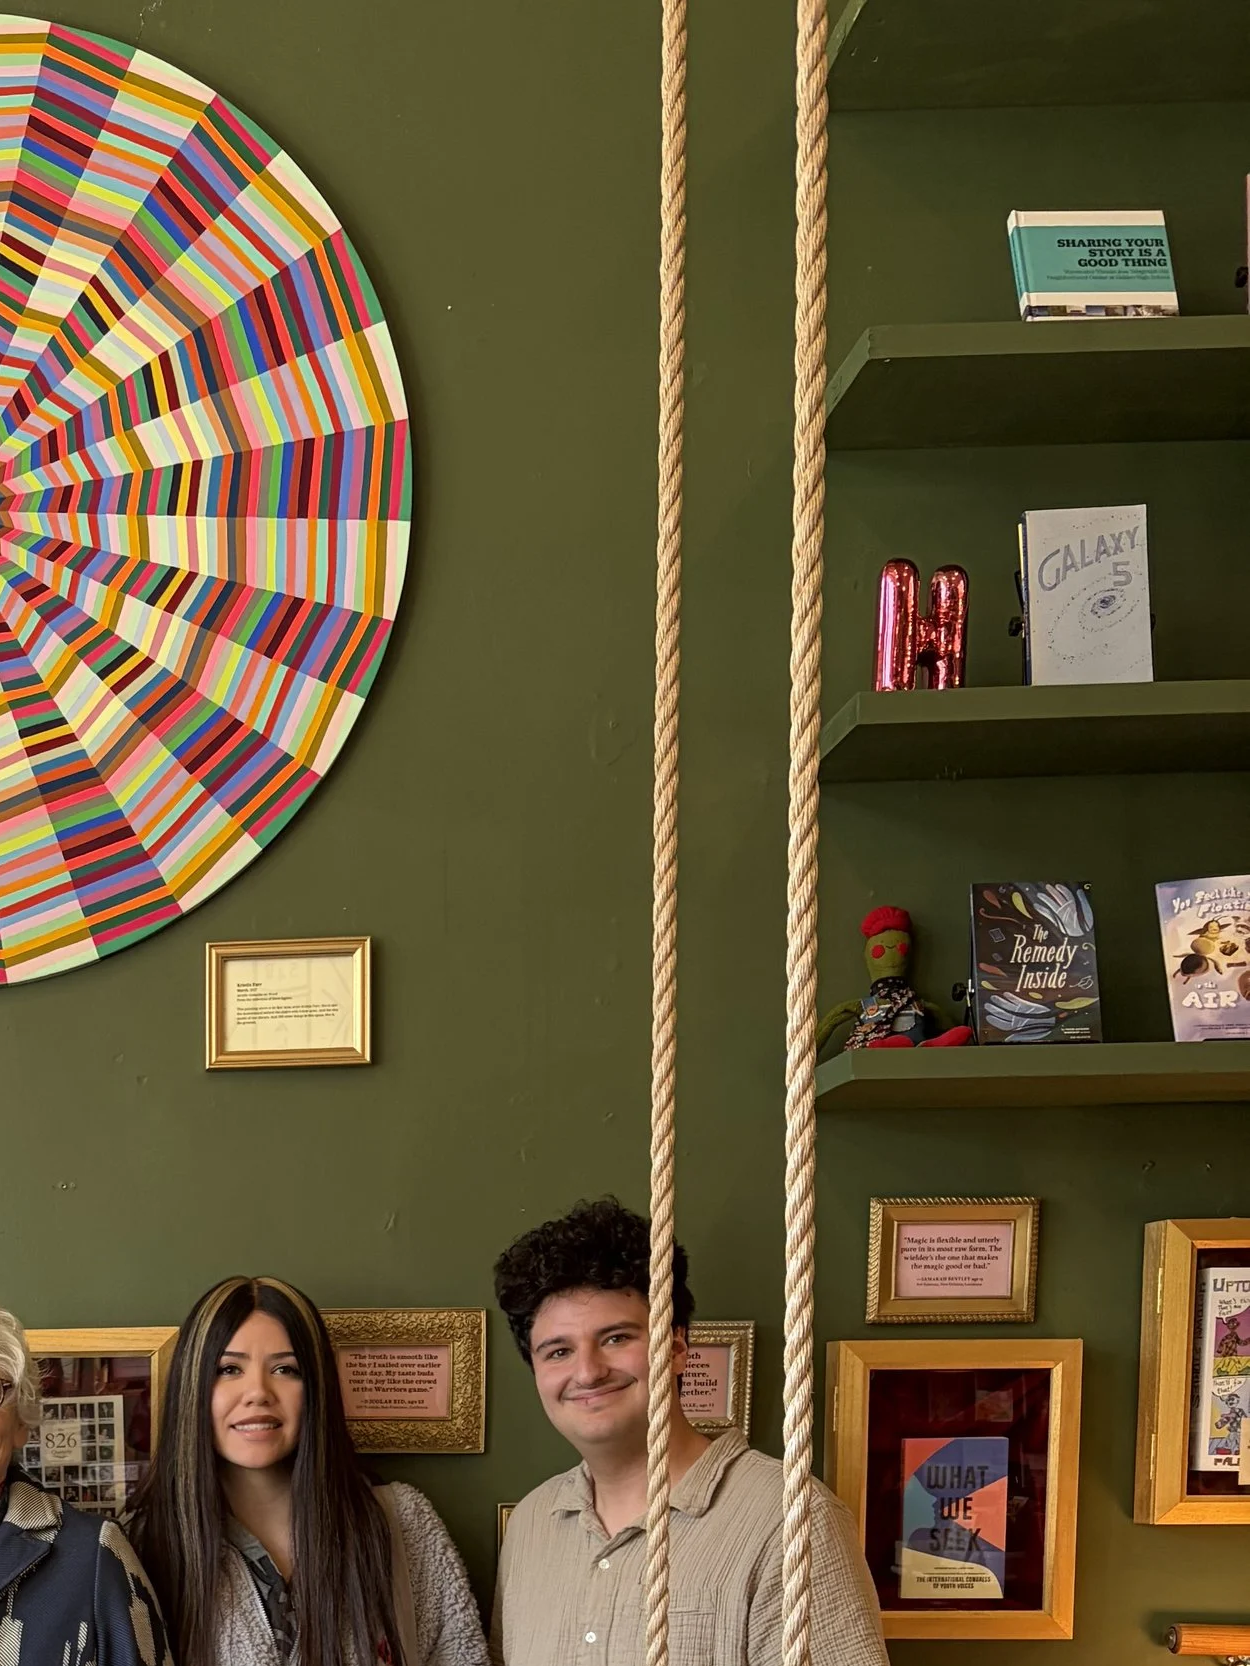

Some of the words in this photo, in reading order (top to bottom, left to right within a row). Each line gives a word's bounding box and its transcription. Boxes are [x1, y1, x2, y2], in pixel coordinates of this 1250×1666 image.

[1057, 239, 1122, 248] SHARING
[1125, 238, 1165, 247] YOUR
[1088, 248, 1135, 257] STORY
[1139, 248, 1152, 257] IS
[1155, 248, 1166, 257] A
[1078, 259, 1119, 267] GOOD
[1121, 258, 1167, 267] THING
[1038, 525, 1139, 591] GALAXY
[1112, 561, 1132, 587] 5
[1172, 897, 1191, 914] You
[1032, 924, 1049, 943] The
[1010, 934, 1079, 969] Remedy
[1015, 963, 1067, 992] Inside
[1182, 990, 1239, 1009] AIR
[978, 1236, 1000, 1245] utterly
[45, 1432, 77, 1449] 826
[926, 1465, 989, 1489] WHAT
[940, 1497, 973, 1520] WE
[930, 1528, 981, 1551] SEEK
